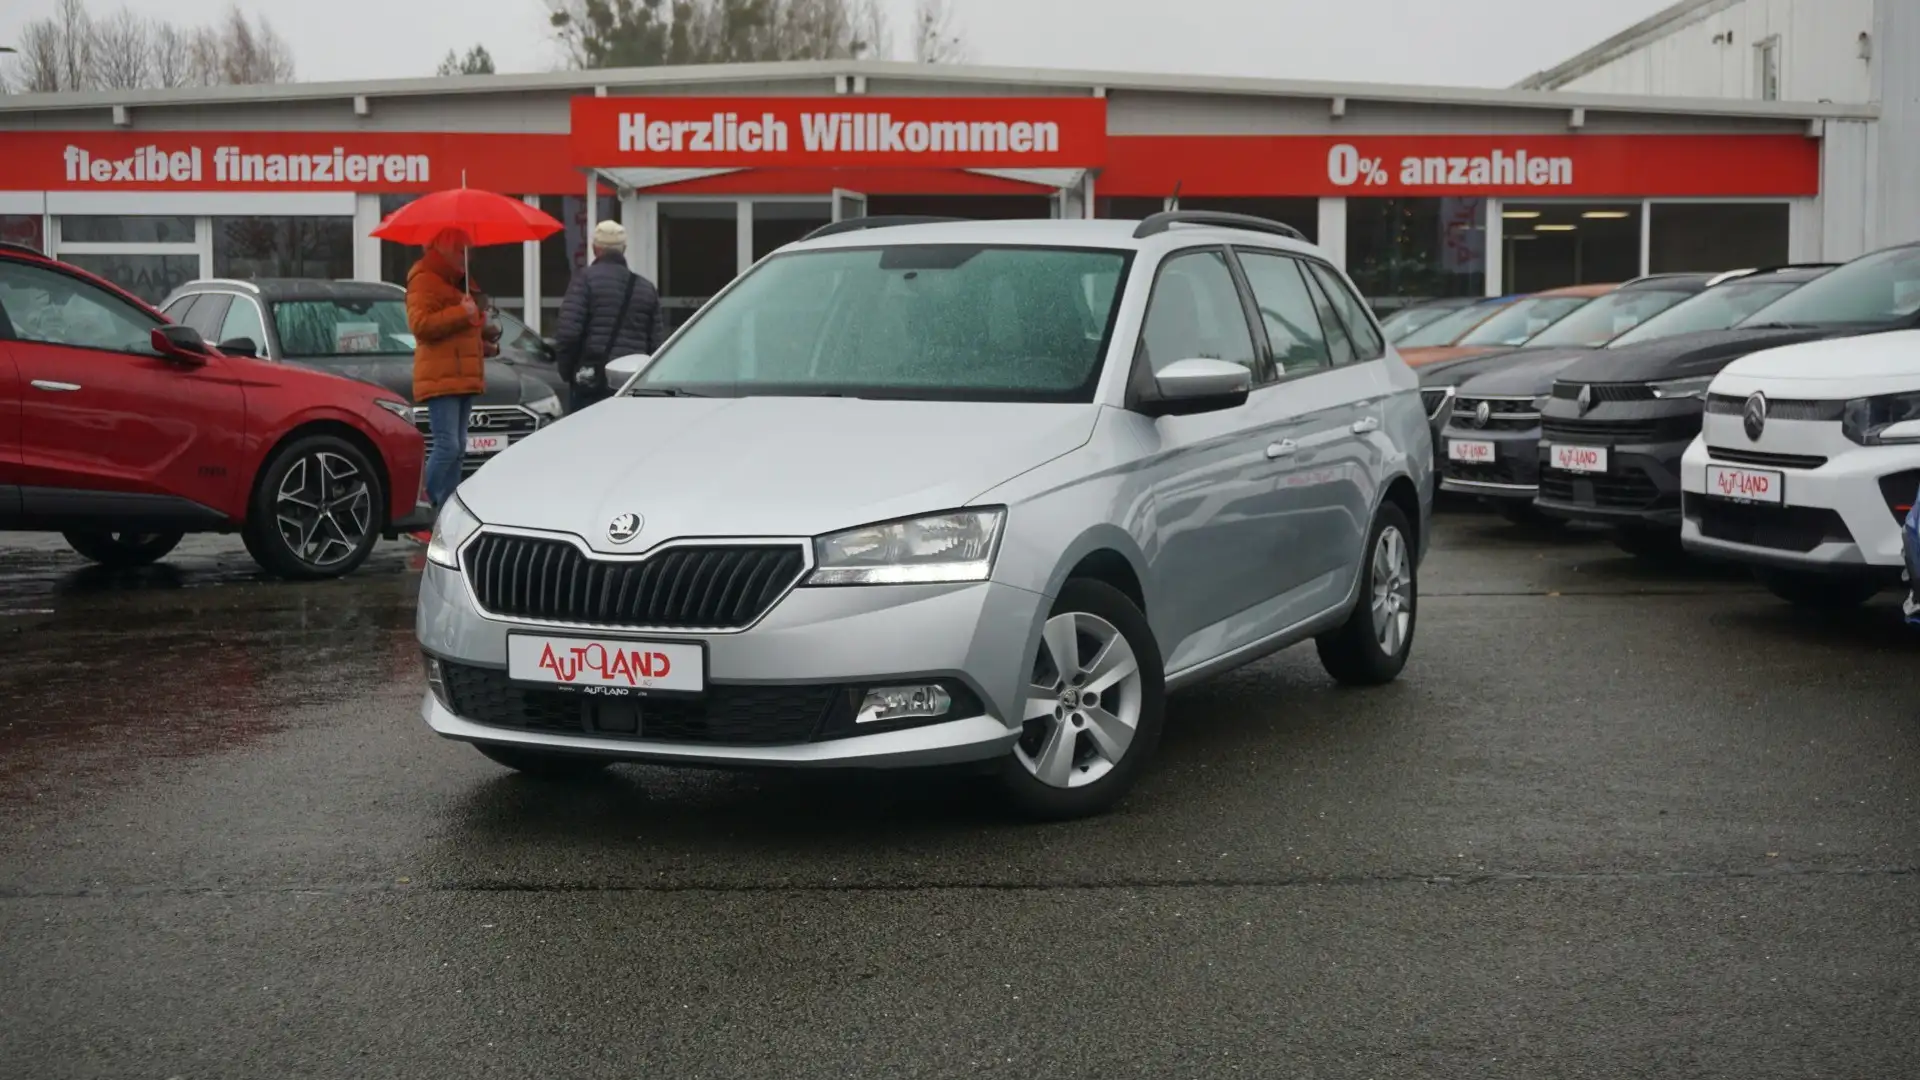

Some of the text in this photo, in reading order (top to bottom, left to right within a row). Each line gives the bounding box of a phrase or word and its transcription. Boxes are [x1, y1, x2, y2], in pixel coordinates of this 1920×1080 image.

[618, 112, 1059, 152] Herzlich Willkommen
[64, 144, 429, 182] flexibel finanzieren
[1328, 143, 1573, 186] 0% anzahlen
[1718, 471, 1768, 497] AUTOLAND
[539, 642, 670, 685] AUTOLAND
[584, 686, 629, 696] AUTOLAND
